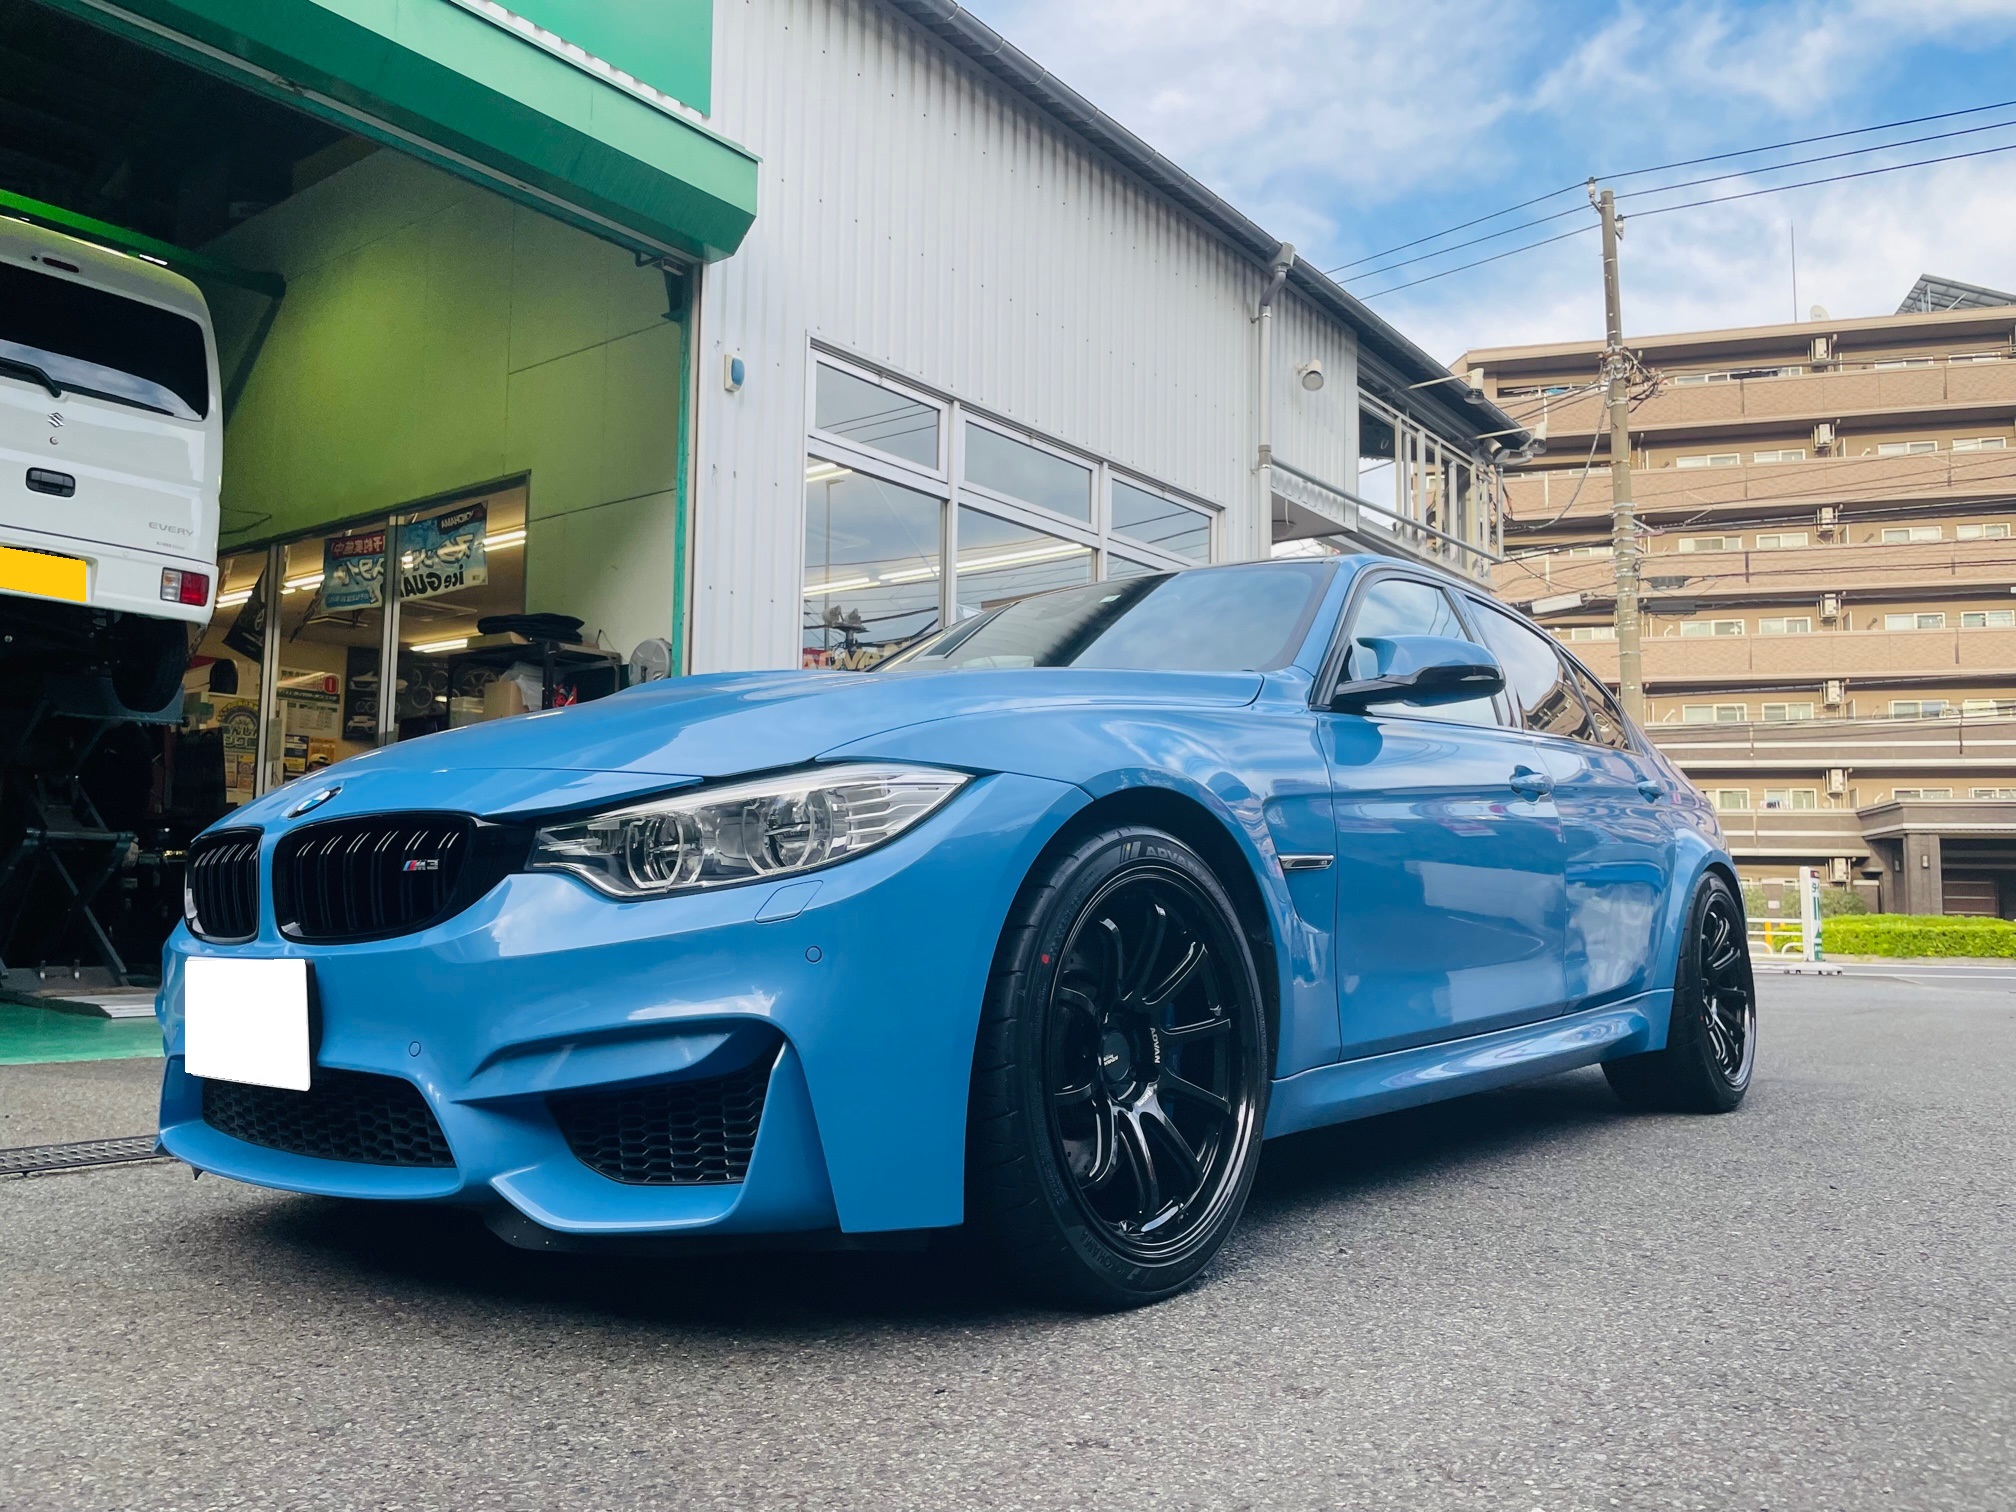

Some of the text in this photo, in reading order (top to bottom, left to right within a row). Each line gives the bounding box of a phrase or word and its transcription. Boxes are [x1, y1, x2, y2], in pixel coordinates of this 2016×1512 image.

[149, 521, 194, 537] EVERY
[413, 859, 439, 871] M3
[1146, 846, 1199, 876] ADVAN
[1149, 1027, 1161, 1064] ADVAN
